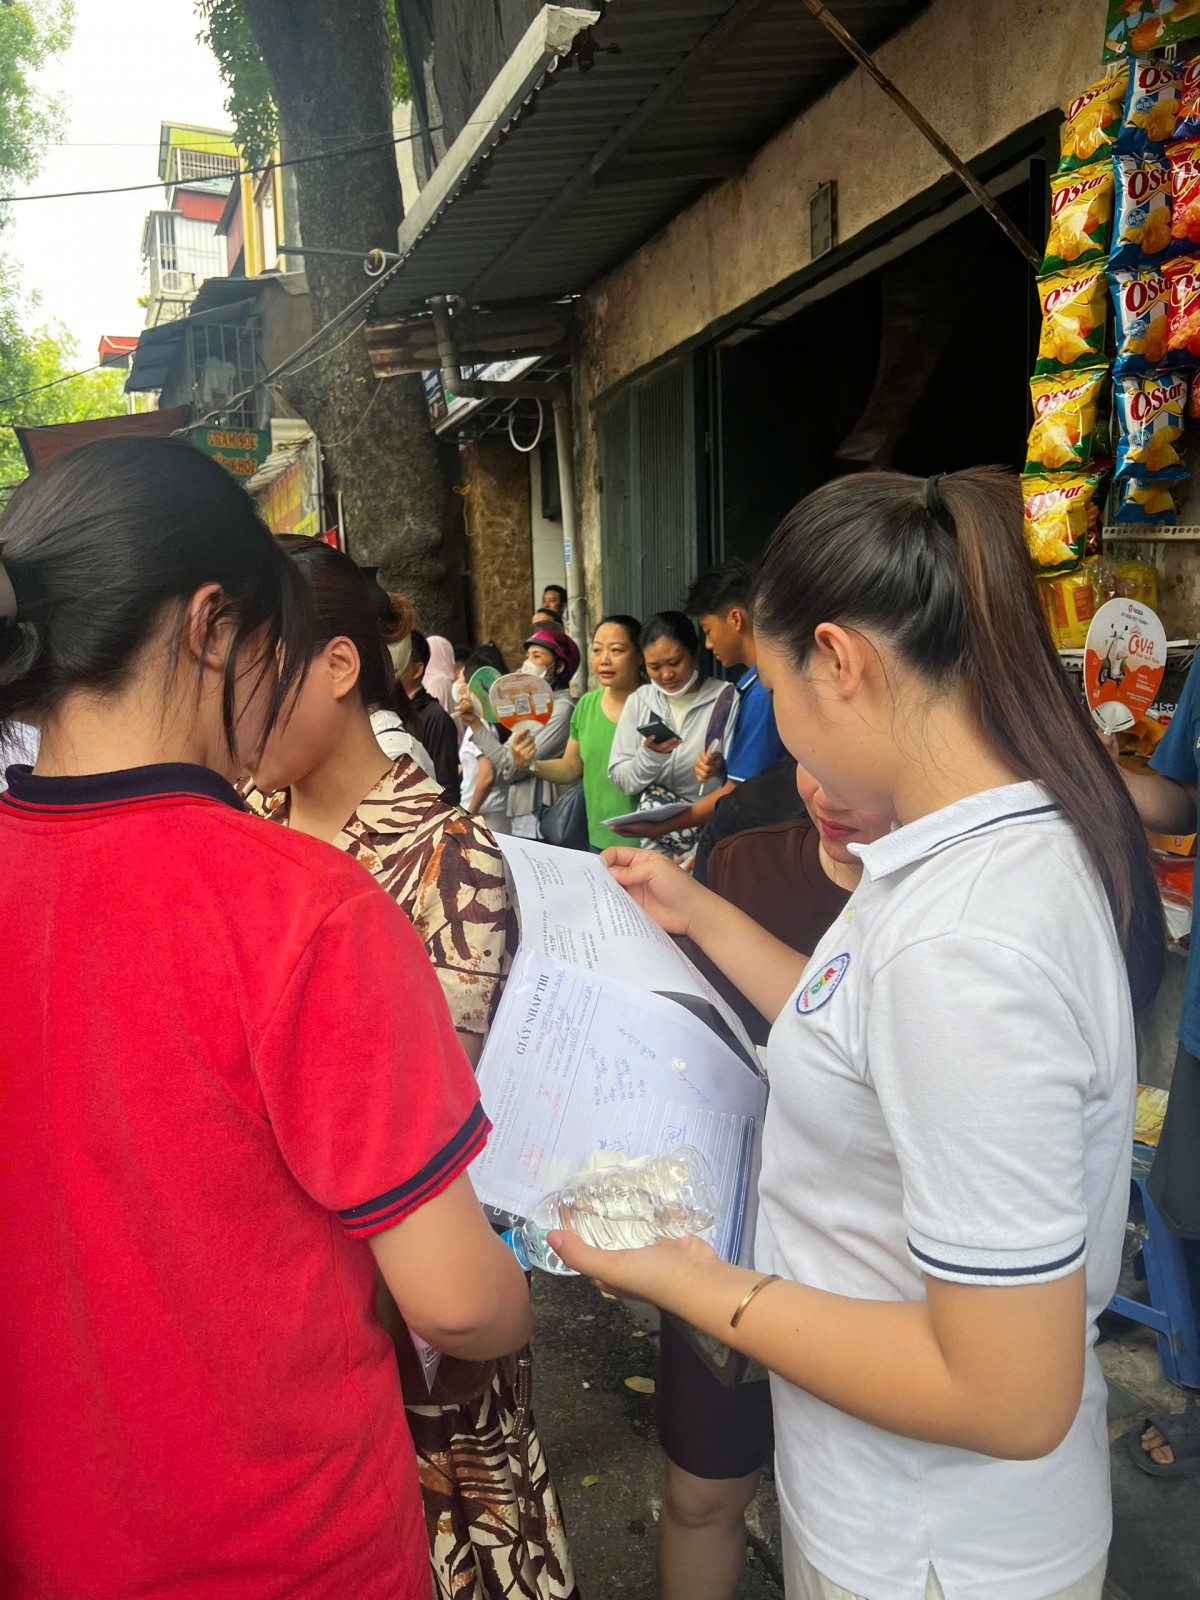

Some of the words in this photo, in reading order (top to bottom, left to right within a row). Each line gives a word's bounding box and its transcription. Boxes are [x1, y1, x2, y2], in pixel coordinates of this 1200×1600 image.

[1068, 80, 1119, 121] O'Star
[1051, 173, 1108, 216] O'Star
[1044, 272, 1098, 315] O'Star
[1036, 382, 1089, 418] O'Star
[1130, 382, 1183, 420] O'Star
[1025, 485, 1085, 519] O'Star
[536, 974, 549, 993] THI
